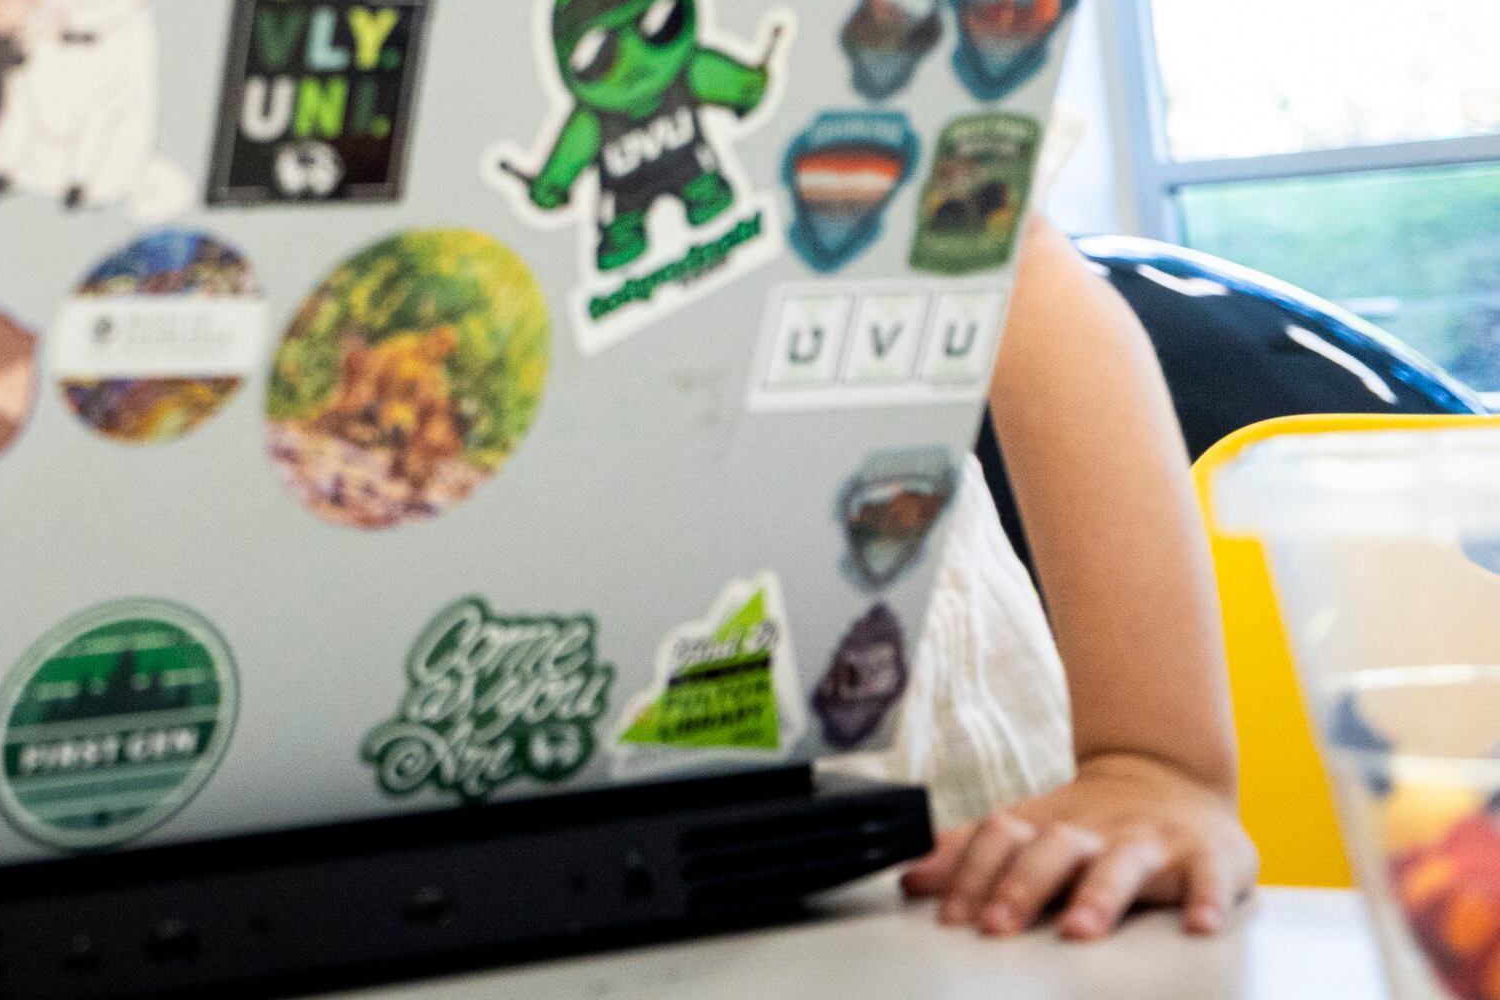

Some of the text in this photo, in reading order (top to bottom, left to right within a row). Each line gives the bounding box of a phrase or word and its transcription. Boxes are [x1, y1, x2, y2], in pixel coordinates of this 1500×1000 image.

[253, 6, 399, 71] VLY.
[240, 74, 391, 143] UNI.
[603, 107, 695, 178] UVU
[409, 599, 593, 683] Come
[19, 735, 120, 774] FIRST
